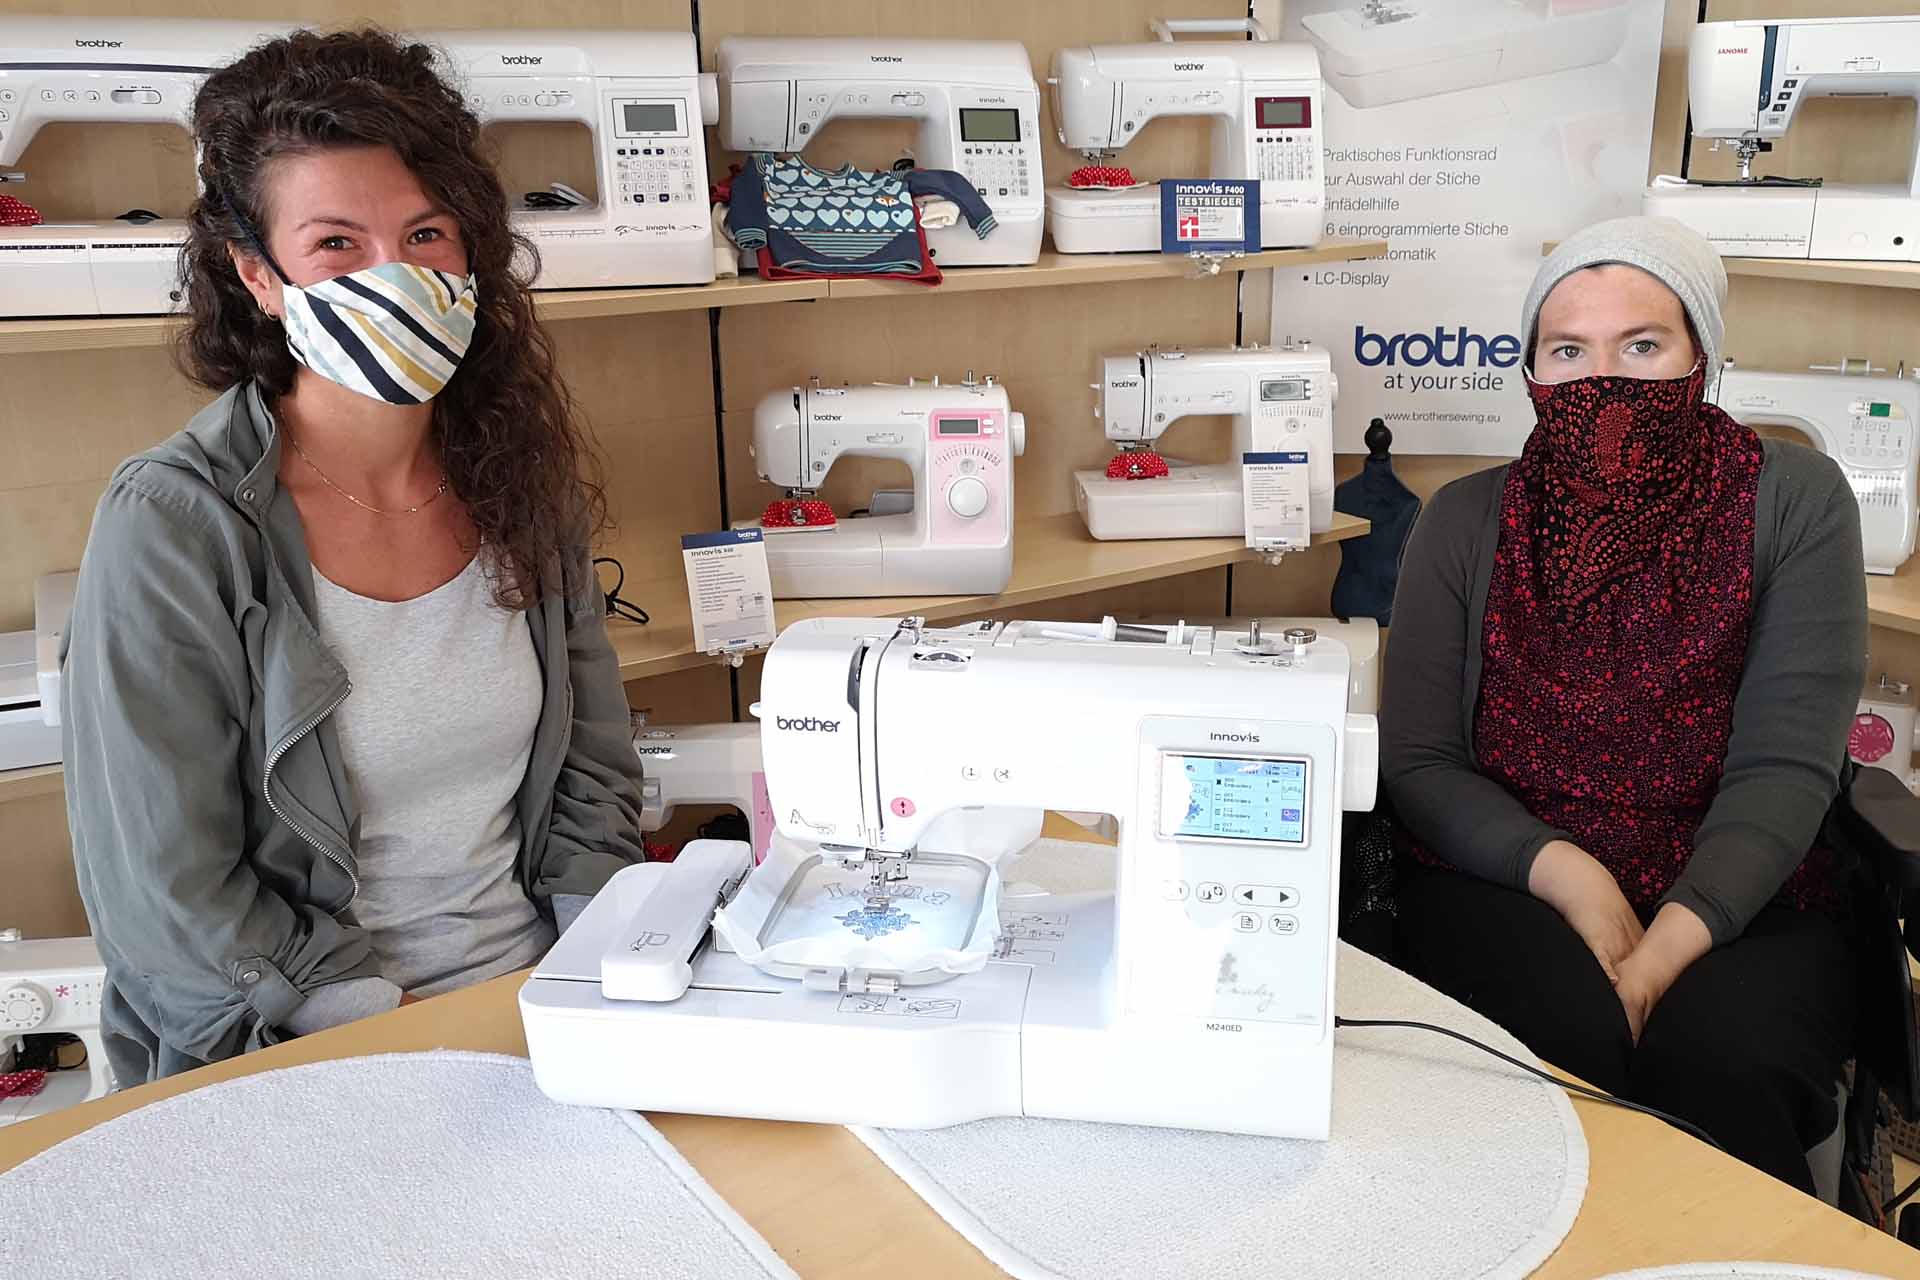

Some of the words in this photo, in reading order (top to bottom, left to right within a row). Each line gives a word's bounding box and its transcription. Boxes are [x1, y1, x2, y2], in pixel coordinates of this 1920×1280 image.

[75, 39, 124, 48] brother
[1718, 47, 1749, 55] JANOME
[501, 55, 543, 65] brother
[1174, 63, 1205, 71] brother
[1323, 148, 1401, 162] Praktisches
[1405, 147, 1498, 162] Funktionsrad
[1324, 174, 1343, 186] zur
[1346, 172, 1405, 186] Auswahl
[1408, 171, 1432, 186] der
[1435, 171, 1481, 186] Stiche
[1225, 185, 1245, 194] F400
[1178, 197, 1243, 206] TESTSIEGER
[1338, 221, 1460, 239] einprogrammierte
[1464, 222, 1510, 237] Stiche
[1315, 271, 1390, 288] LC-Display
[1111, 380, 1138, 388] brother
[1384, 374, 1405, 390] at
[1409, 376, 1457, 393] your
[1461, 372, 1504, 391] side
[814, 414, 842, 422] brother
[1384, 411, 1501, 424] www.brothersewing.eu
[776, 715, 841, 733] brother
[639, 746, 672, 755] brother
[1206, 1023, 1243, 1033] M240ED
